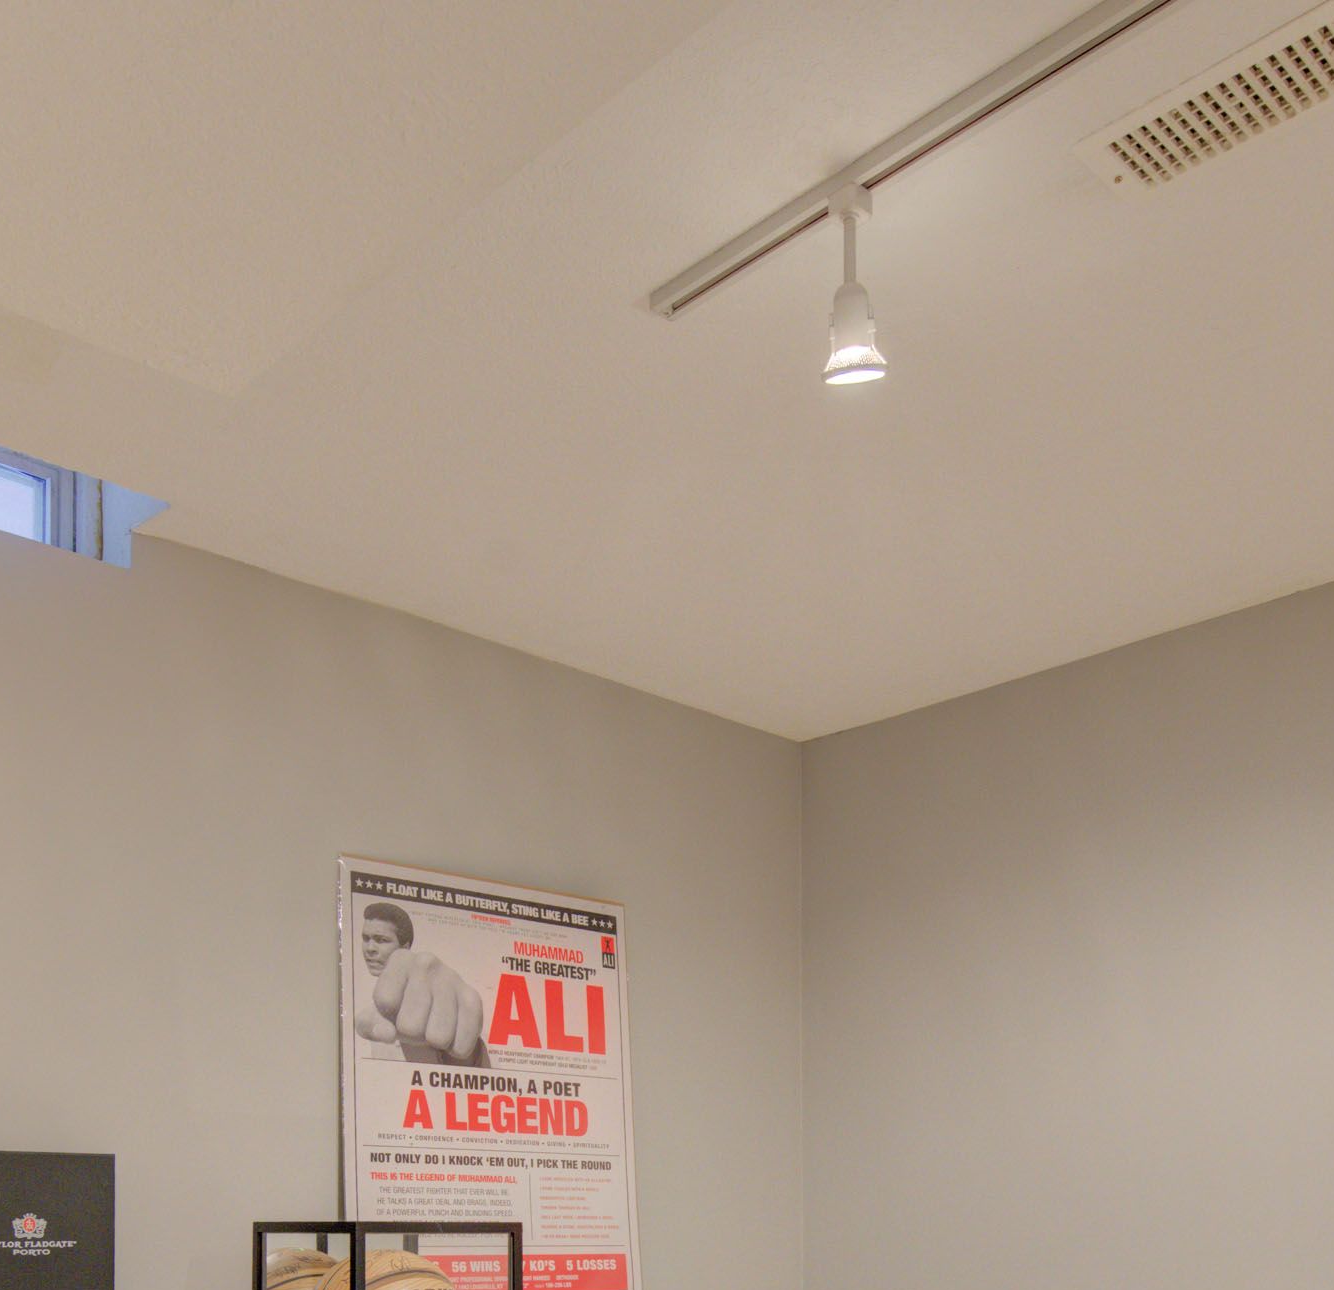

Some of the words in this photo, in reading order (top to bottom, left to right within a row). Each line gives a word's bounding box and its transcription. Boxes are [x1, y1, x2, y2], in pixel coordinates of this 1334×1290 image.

[387, 882, 418, 898] FLOAT
[421, 888, 444, 902] LIKE
[445, 893, 453, 904] A
[455, 894, 511, 914] BUTTERFLY,
[511, 903, 540, 918] STING
[541, 909, 561, 922] LIKE
[562, 912, 570, 923] A
[571, 914, 589, 927] BEE
[513, 942, 584, 964] MUHAMMAD
[488, 974, 606, 1055] ALI
[411, 1070, 423, 1086] A
[429, 1072, 523, 1096] CHAMPION,
[527, 1080, 538, 1094] A
[543, 1082, 581, 1098] POET
[403, 1089, 433, 1130] A
[445, 1091, 589, 1137] LEGEND
[415, 1134, 453, 1142] CONFIDENCE
[371, 1152, 391, 1163] NOT
[395, 1153, 421, 1164] ONLY
[425, 1154, 439, 1165] DO
[449, 1155, 483, 1166] KNOCK
[507, 1158, 528, 1170] OUT,
[537, 1159, 559, 1169] PICK
[561, 1160, 579, 1170] THE
[581, 1160, 611, 1171] ROUND
[371, 1172, 389, 1180] THIS
[390, 1172, 398, 1180] IS
[400, 1172, 413, 1181] THE
[415, 1173, 445, 1182] LEGEND
[447, 1174, 457, 1182] OF
[458, 1174, 503, 1184] MUHAMMAD
[379, 1186, 392, 1194] THE
[393, 1186, 424, 1194] GREATEST
[13, 1248, 51, 1256] PORTO
[25, 1240, 74, 1248] FLADGATE
[451, 1261, 467, 1272] 56
[469, 1260, 501, 1272] WINS
[567, 1260, 573, 1271] 5
[577, 1259, 617, 1271] LOSSES
